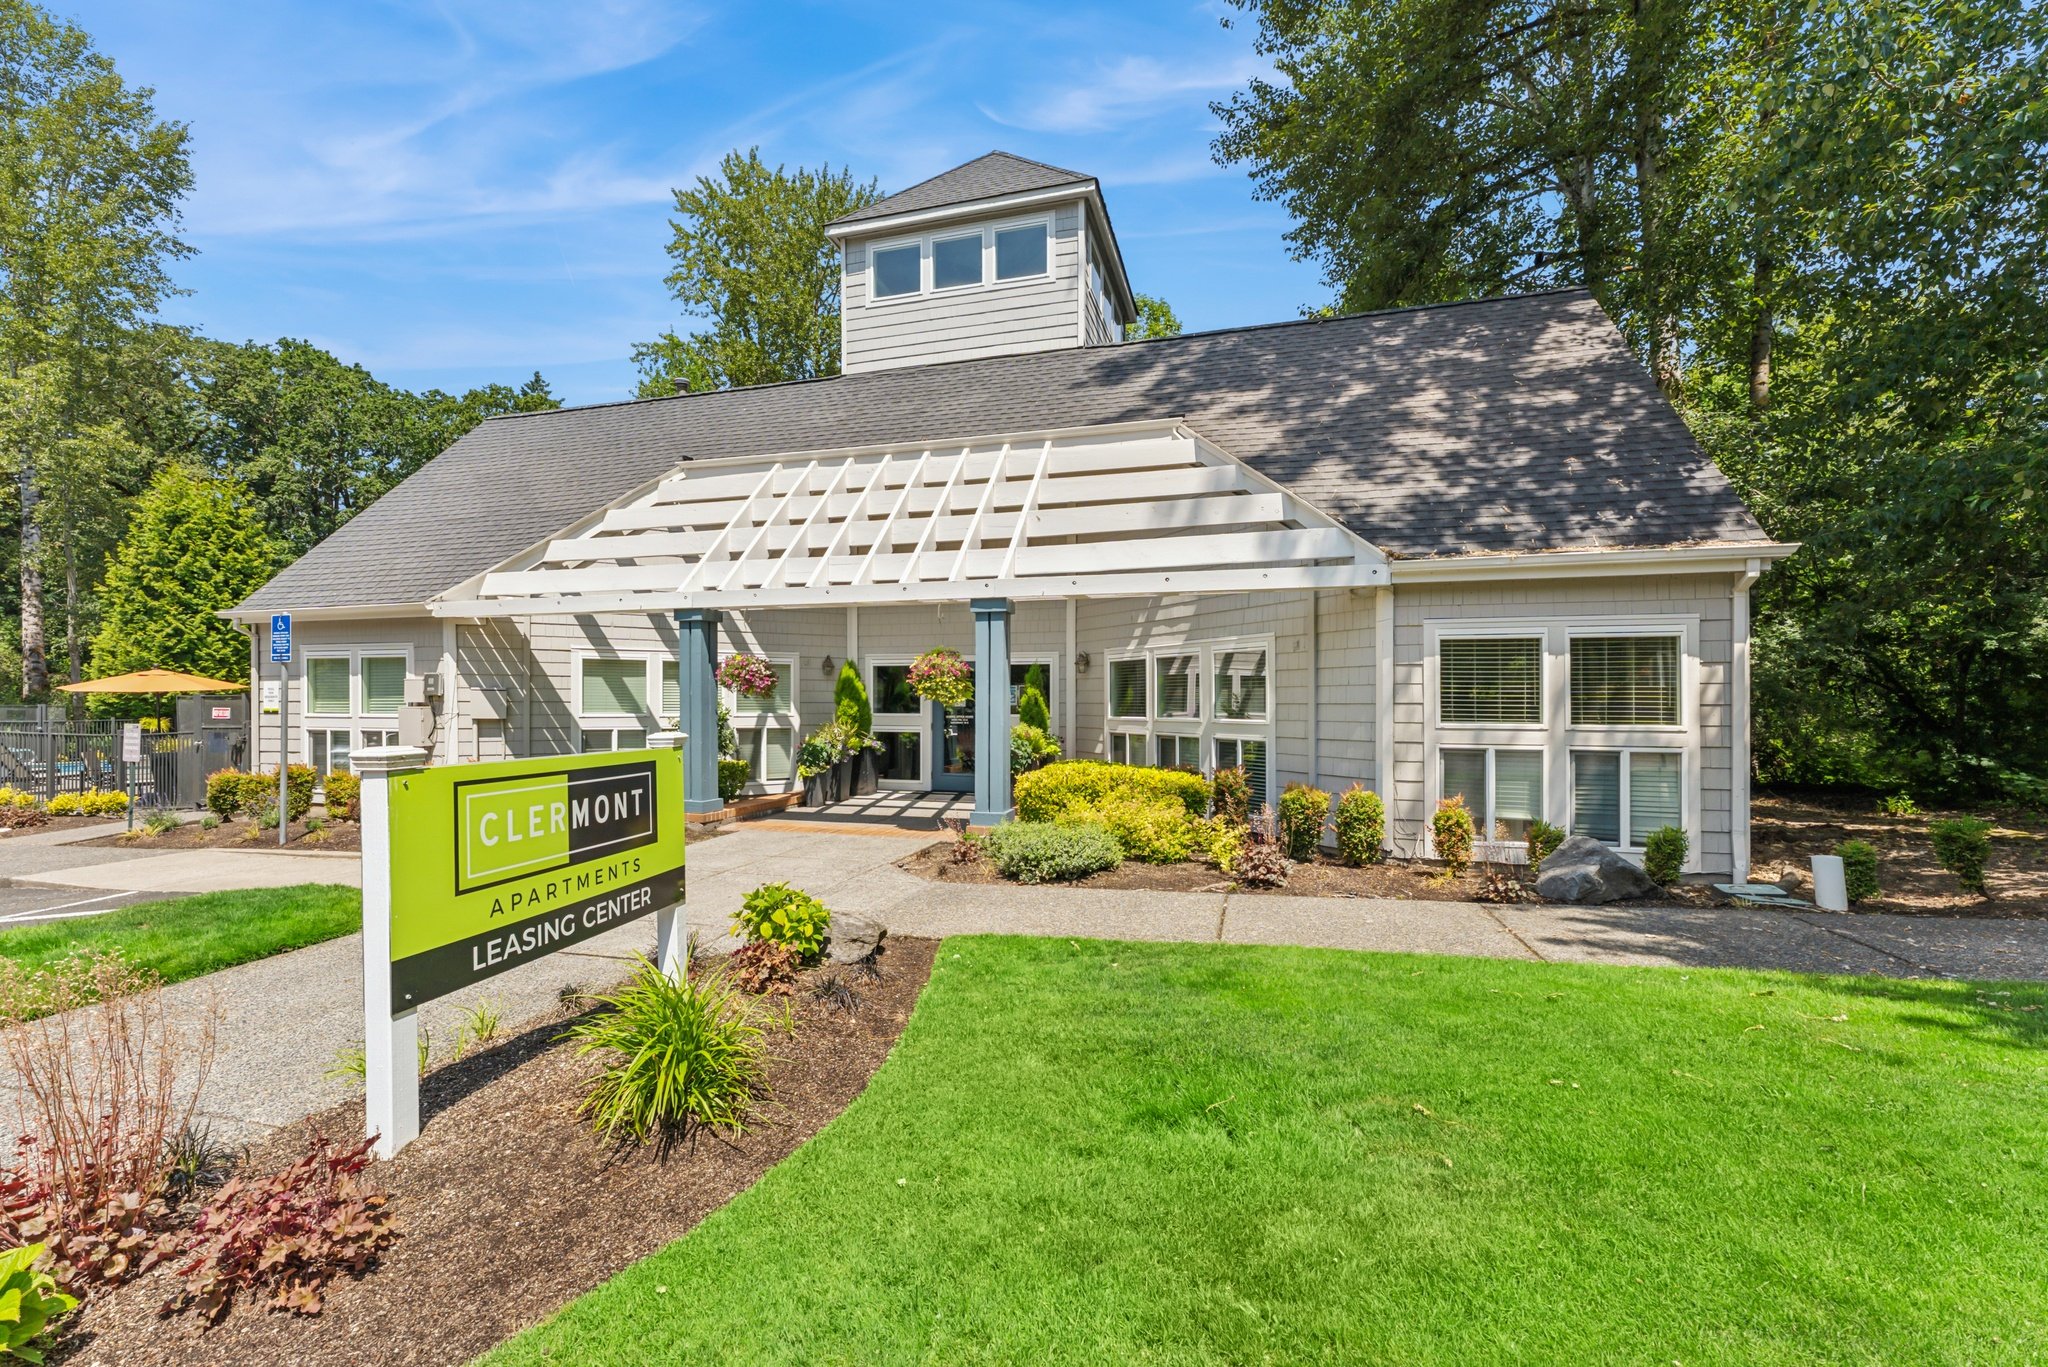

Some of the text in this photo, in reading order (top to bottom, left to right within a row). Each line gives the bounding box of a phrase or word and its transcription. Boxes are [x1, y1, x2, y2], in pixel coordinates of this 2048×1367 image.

[480, 789, 643, 847] CLERMONT
[490, 858, 641, 918] APARTMENTS
[473, 886, 652, 971] LEASING CENTER
